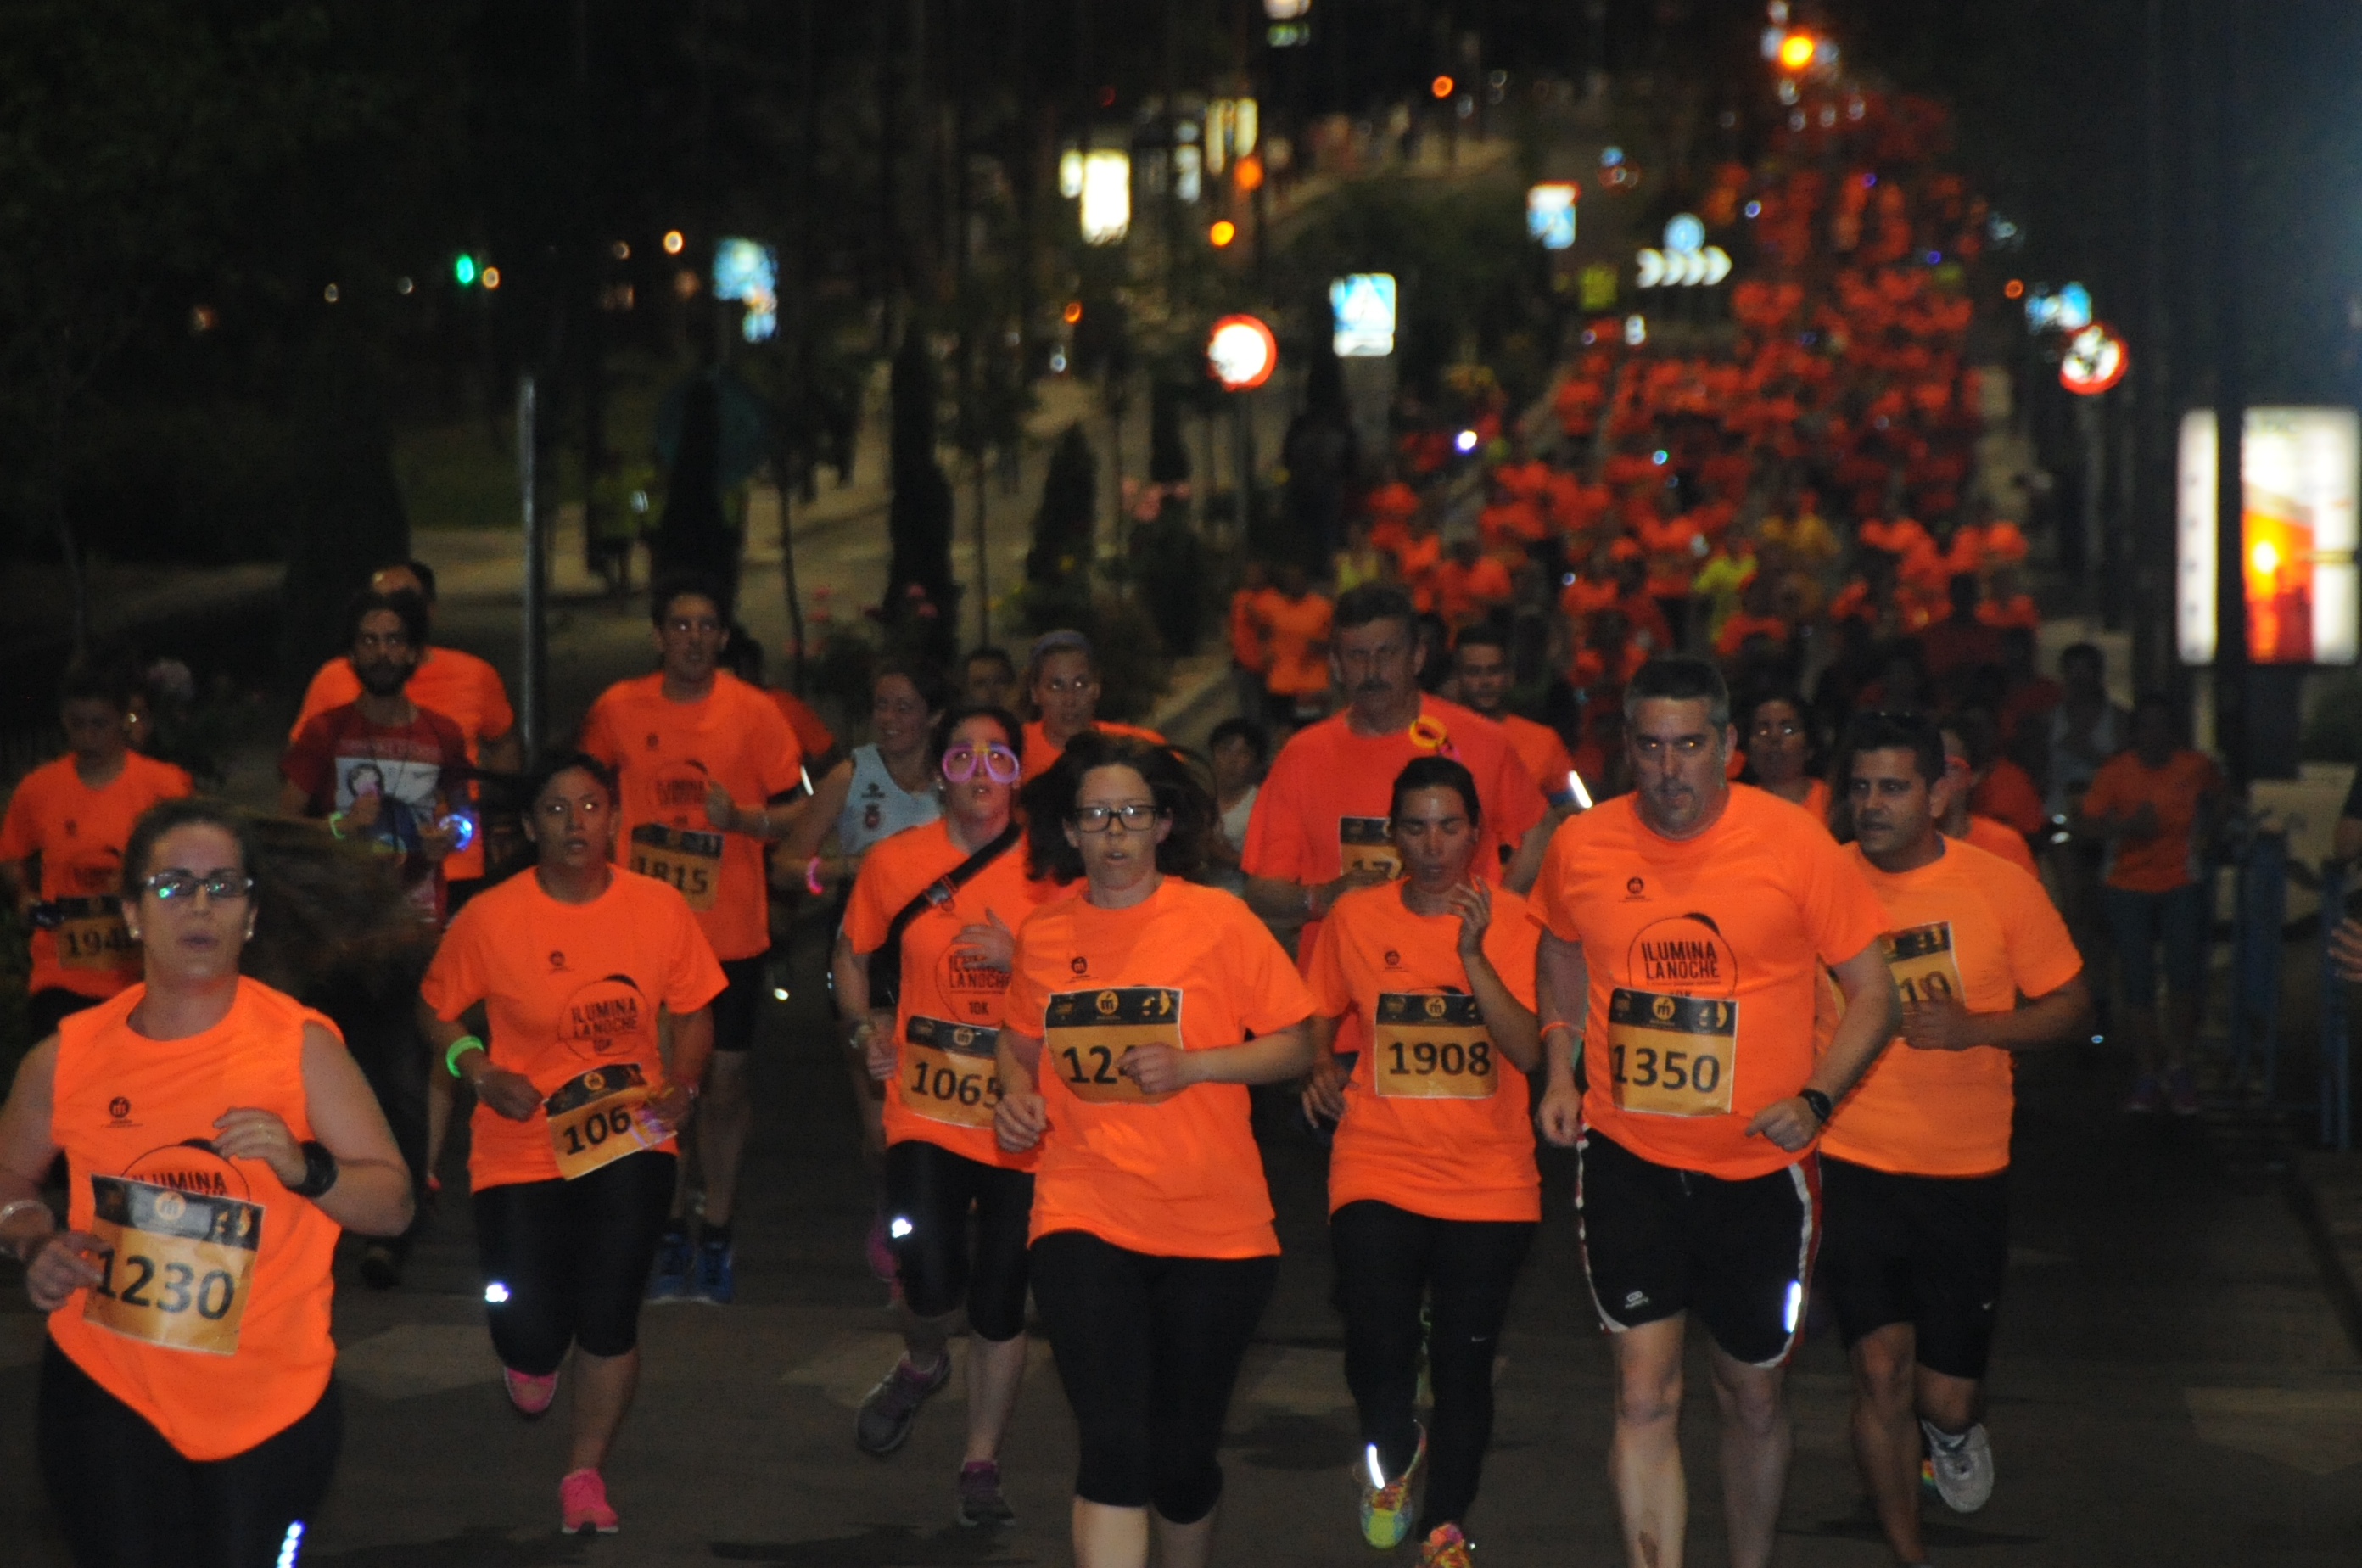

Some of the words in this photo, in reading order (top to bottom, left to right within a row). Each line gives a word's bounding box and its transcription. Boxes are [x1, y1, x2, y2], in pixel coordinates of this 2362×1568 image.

[1641, 941, 1718, 963] ILUMINA
[1062, 1044, 1137, 1084] 12
[1388, 1041, 1491, 1076] 1908
[1614, 1044, 1720, 1093] 1350
[910, 1061, 1006, 1110] 1065
[563, 1105, 632, 1156] 106
[132, 1171, 228, 1195] UMINA
[97, 1247, 235, 1320] 1230
